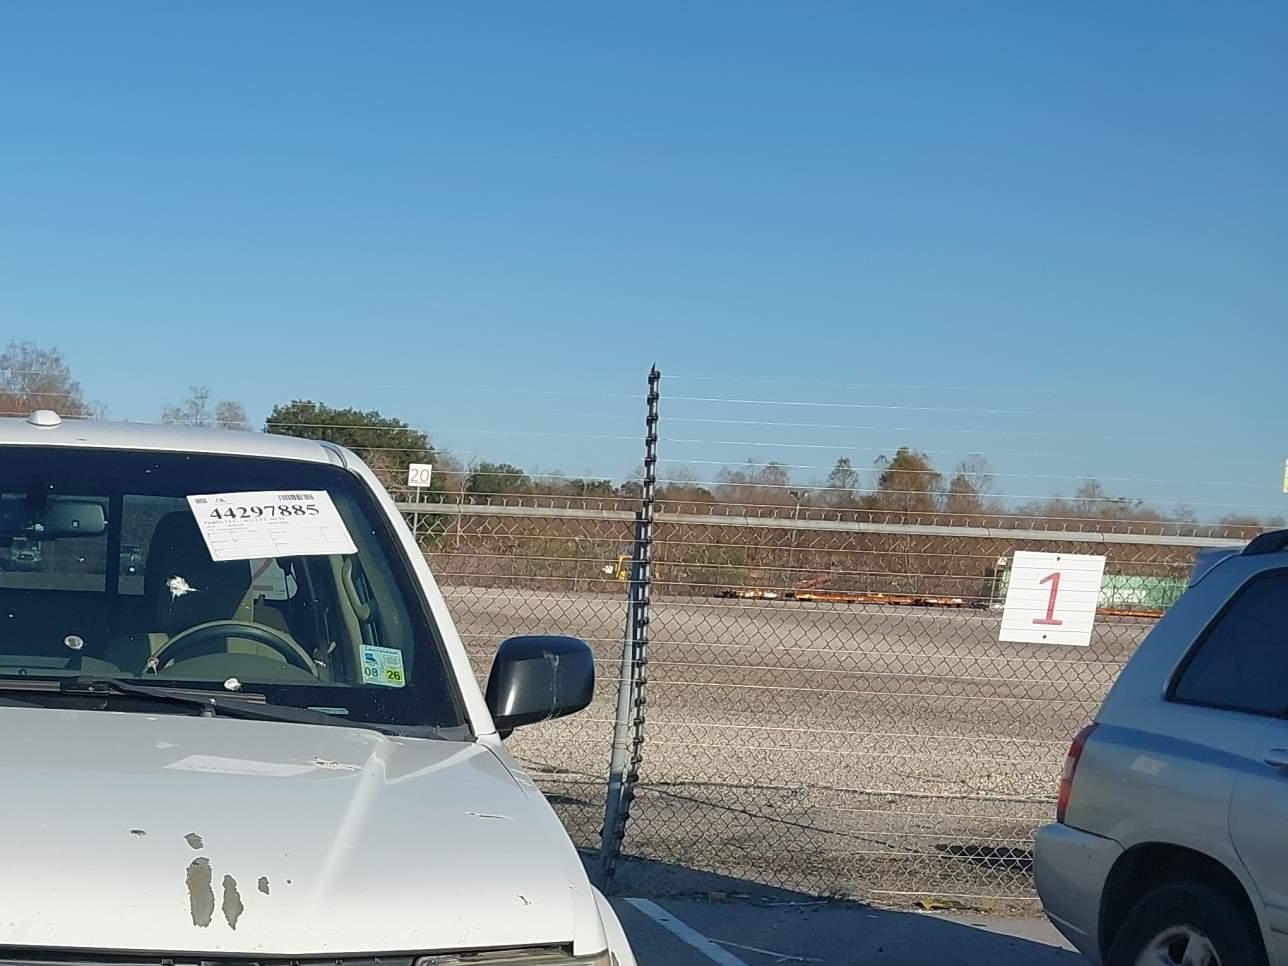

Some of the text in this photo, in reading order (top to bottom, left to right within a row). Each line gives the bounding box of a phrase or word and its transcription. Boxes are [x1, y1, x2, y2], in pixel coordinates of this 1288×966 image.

[410, 468, 429, 482] 20
[209, 503, 320, 520] 44297885
[1032, 572, 1063, 626] 1
[364, 667, 401, 681] 08 26
